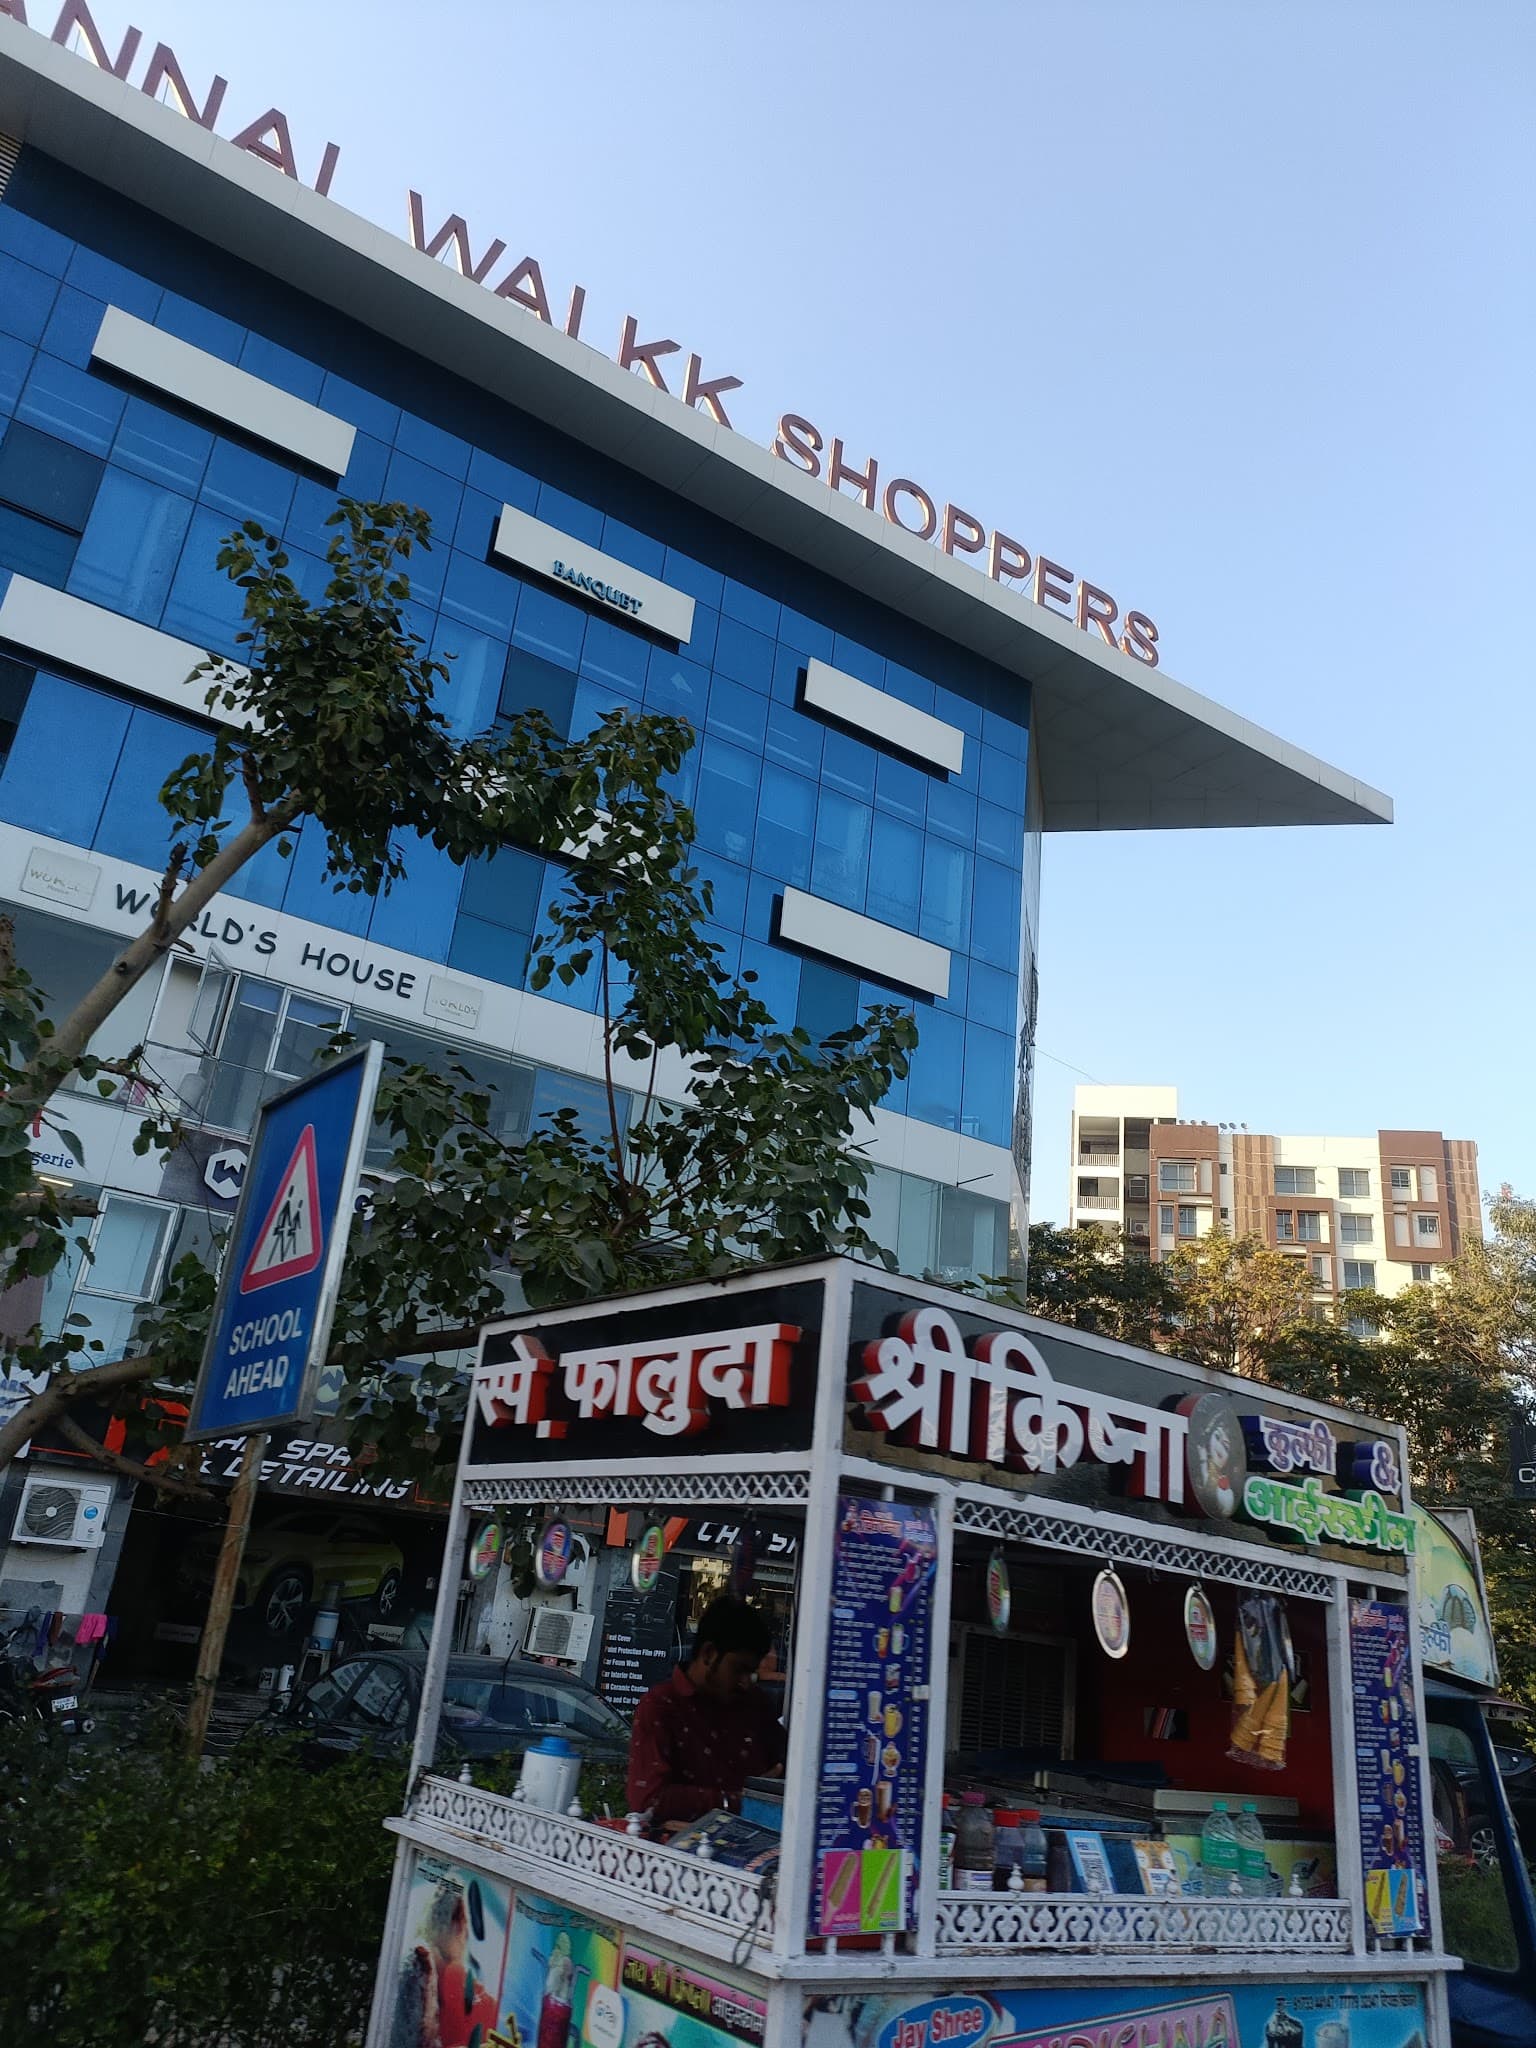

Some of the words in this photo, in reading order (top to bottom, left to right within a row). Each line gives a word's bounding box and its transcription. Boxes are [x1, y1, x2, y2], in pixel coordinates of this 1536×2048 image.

[772, 413, 1160, 667] SHOPPERS
[553, 560, 642, 616] BANQUET
[301, 942, 417, 999] HOUSE
[31, 1150, 74, 1169] gerie
[228, 1308, 303, 1356] SCHOOL
[224, 1356, 290, 1400] AHEAD
[559, 1322, 792, 1437] फालुदा
[277, 1438, 353, 1467] SPA
[1260, 1415, 1337, 1476] कुल्फी
[1370, 1440, 1401, 1495] &
[891, 2017, 928, 2048] Jay
[930, 2004, 985, 2043] Shree
